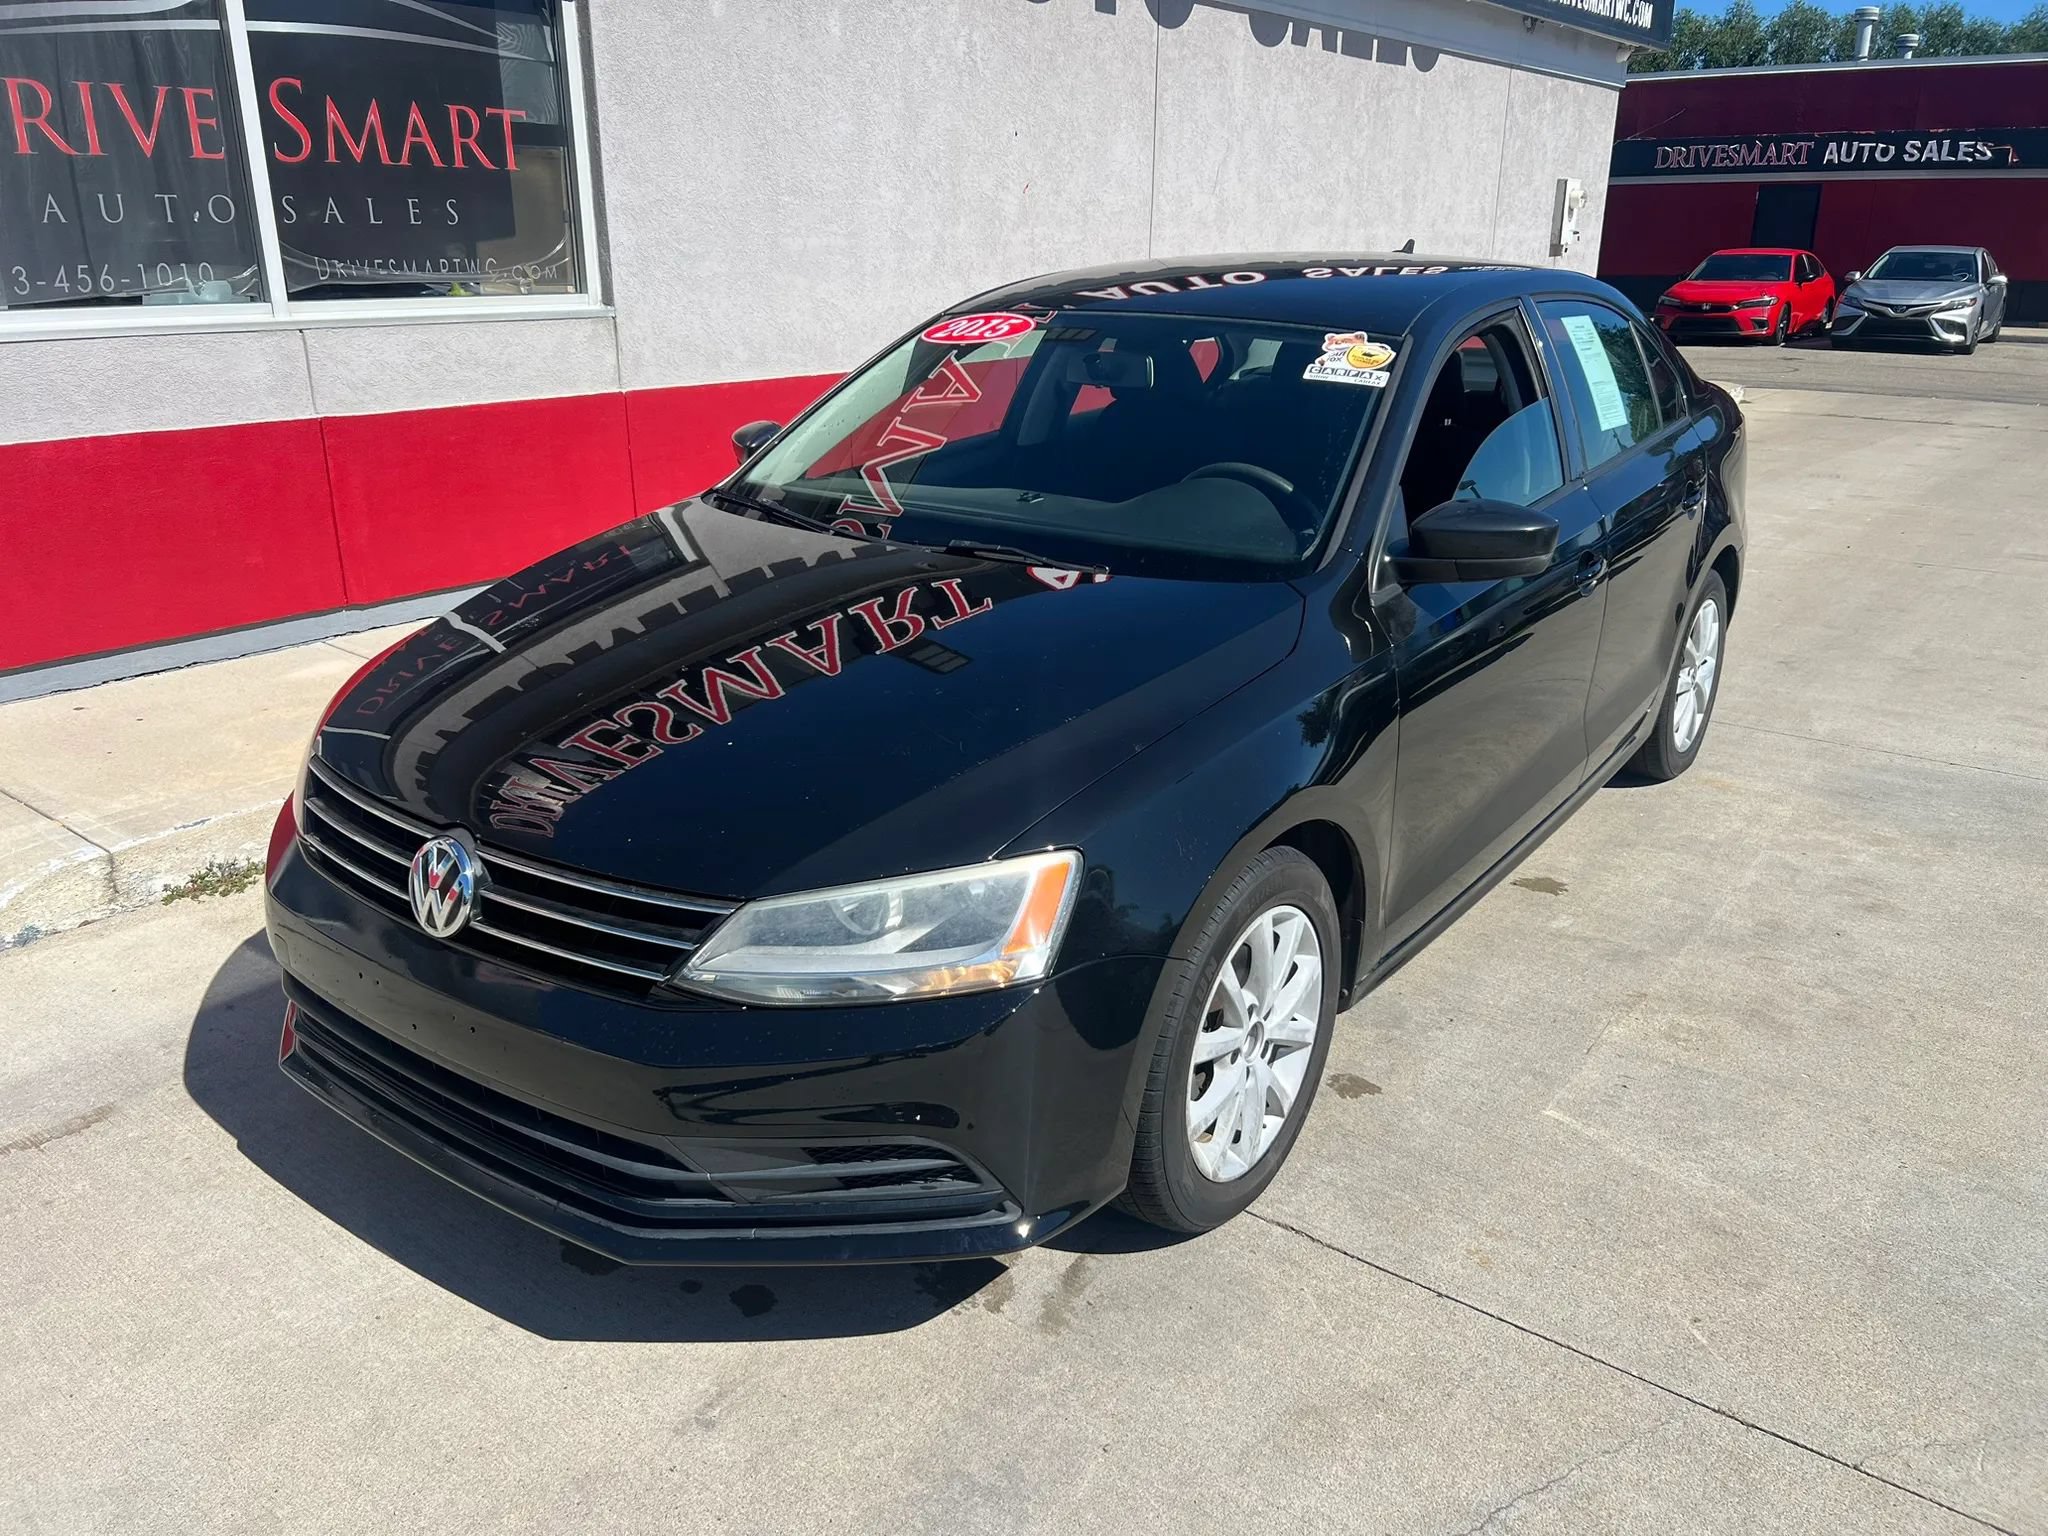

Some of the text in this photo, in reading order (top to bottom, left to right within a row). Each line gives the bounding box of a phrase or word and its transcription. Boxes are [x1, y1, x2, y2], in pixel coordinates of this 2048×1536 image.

[1556, 0, 1653, 29] MARTWC.COM
[268, 77, 527, 172] SMART
[1654, 140, 1995, 170] DRIVESMART AUTO SALES
[42, 193, 460, 226] AUTO SALES
[930, 318, 1024, 338] 2015
[1309, 365, 1383, 381] CARFAX
